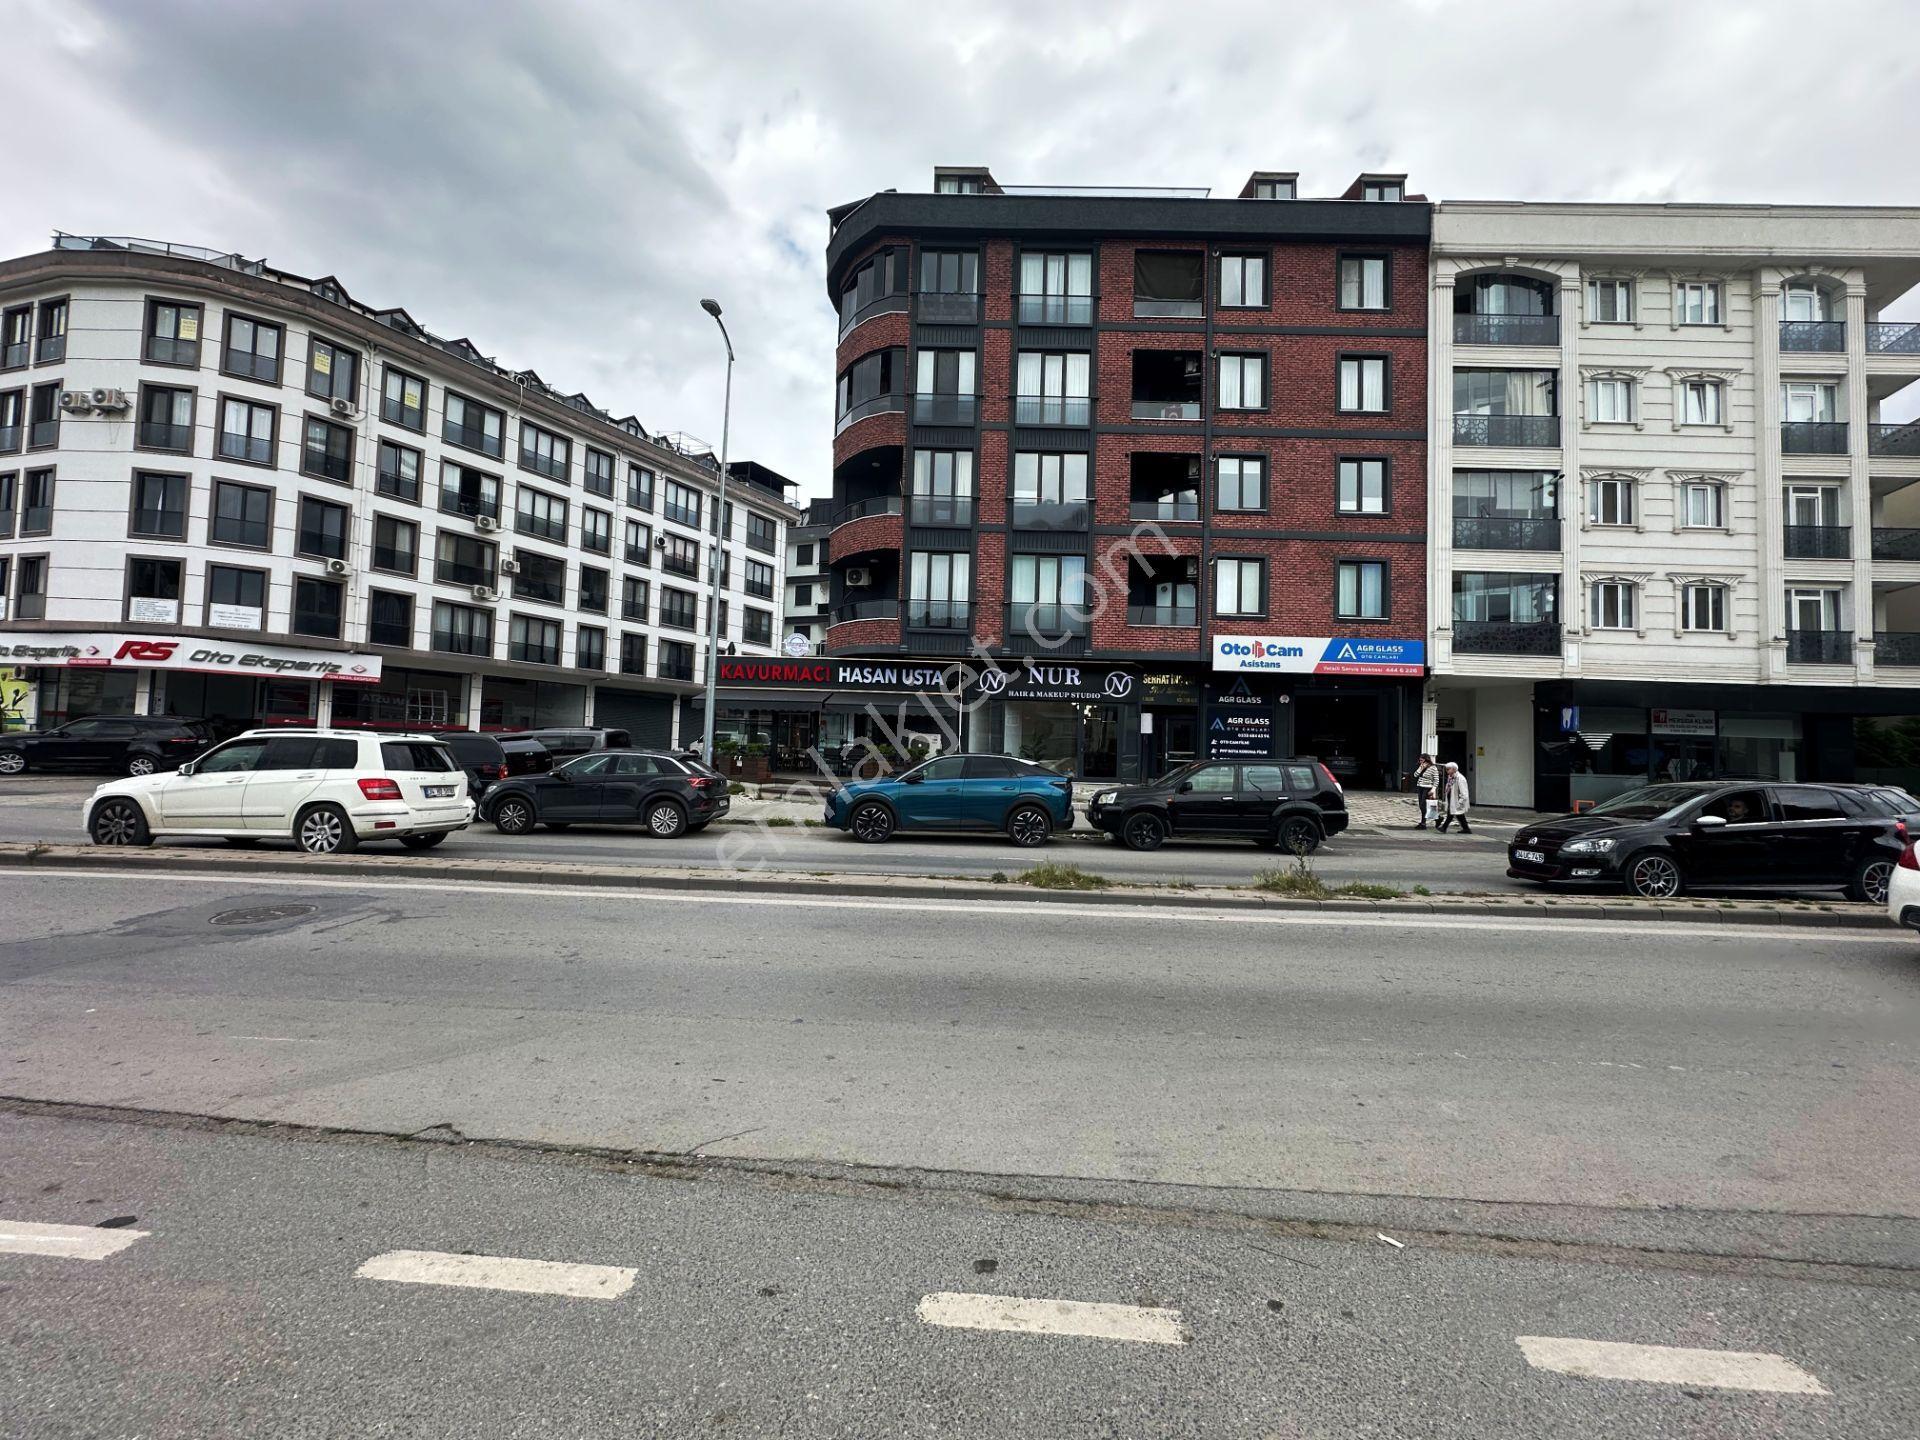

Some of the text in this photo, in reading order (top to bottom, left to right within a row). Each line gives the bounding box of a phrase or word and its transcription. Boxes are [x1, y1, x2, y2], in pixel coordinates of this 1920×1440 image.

[1221, 643, 1303, 657] Oto Cam
[1376, 645, 1404, 653] GLASS
[114, 640, 343, 673] RS Oto Ekspertiz
[1240, 660, 1281, 668] Asistans
[721, 663, 945, 686] KAVURMACI HASAN USTA
[1027, 667, 1082, 686] NUR
[1236, 696, 1262, 704] GLASS
